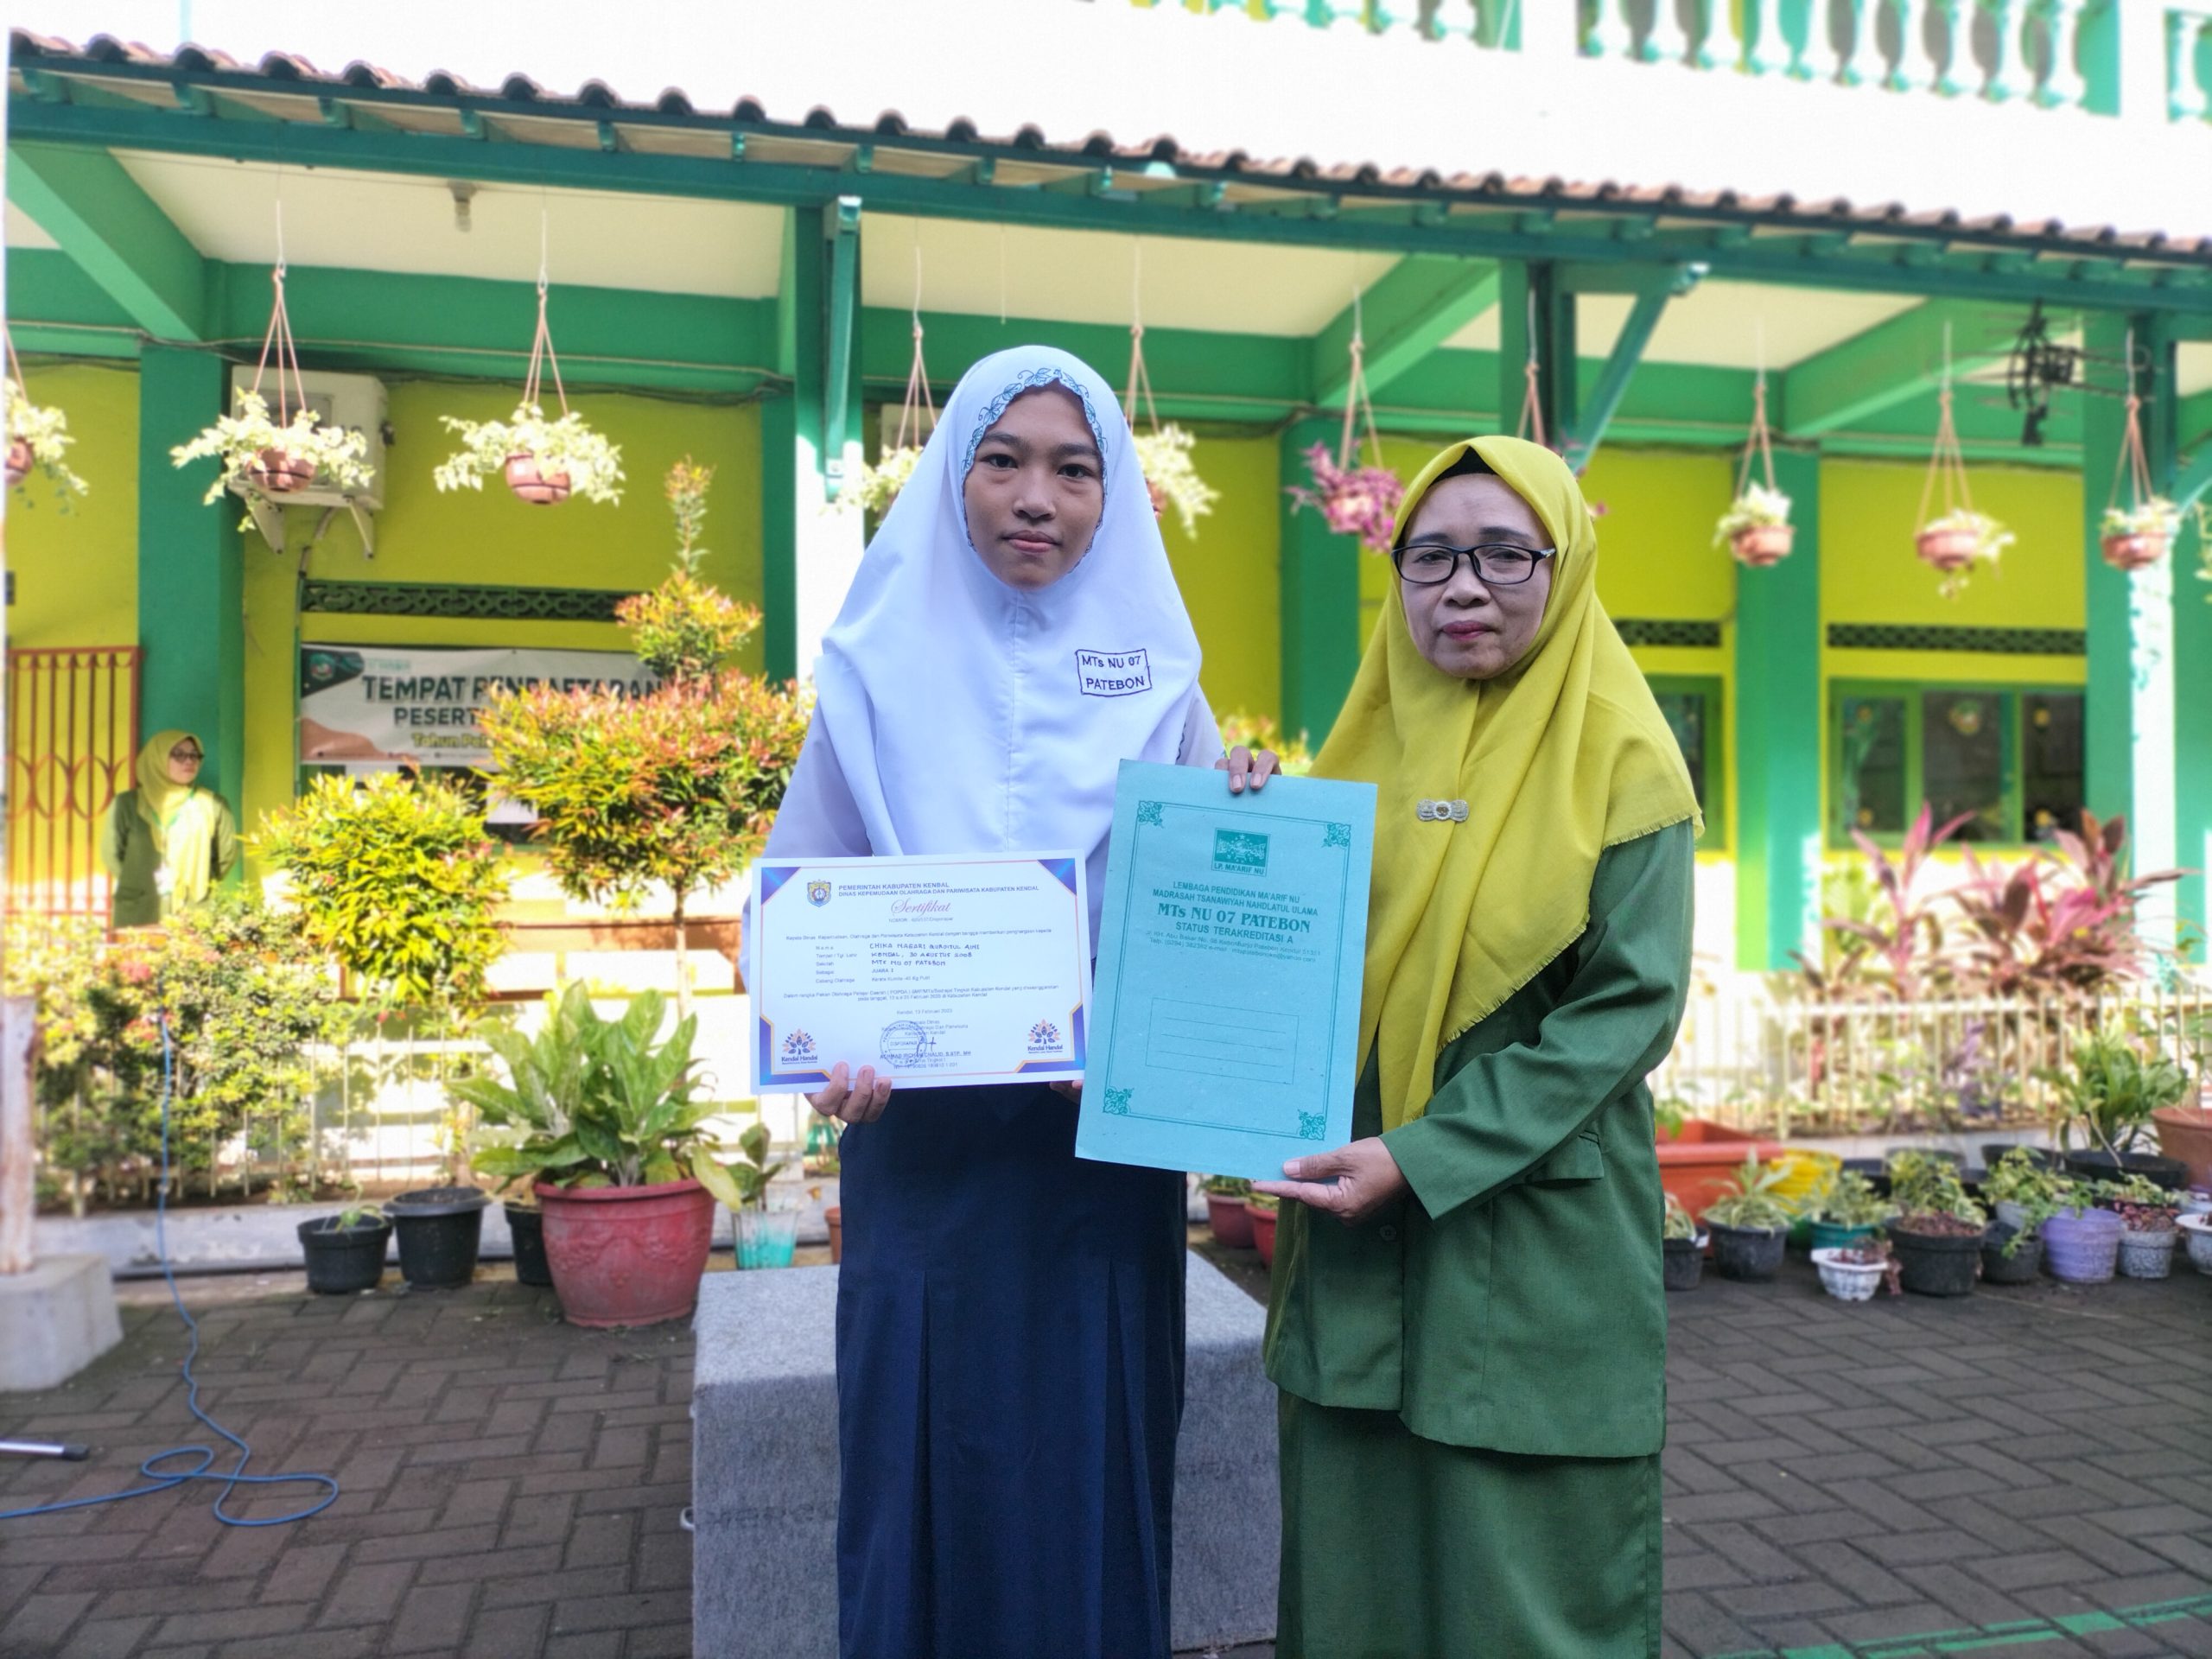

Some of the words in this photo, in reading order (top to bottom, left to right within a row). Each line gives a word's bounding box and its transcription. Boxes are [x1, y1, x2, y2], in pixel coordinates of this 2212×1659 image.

[1081, 655, 1104, 668] MTs
[1108, 658, 1124, 669] NU
[1128, 655, 1141, 666] 07
[362, 676, 467, 701] TEMPAT
[1086, 676, 1145, 690] PATEBON
[393, 707, 486, 726] PESERT
[411, 733, 459, 747] Tahun
[1225, 864, 1252, 873] MA'ARIF
[1153, 888, 1195, 901] MADRASAH
[1197, 893, 1244, 907] TSANAWIYAH
[1246, 899, 1290, 913] NAHDLATUL
[1292, 906, 1319, 916] ULAMA
[1173, 881, 1210, 892] LEMBAGA
[1211, 886, 1256, 898] PENDIDIKAN
[1258, 891, 1288, 902] MA'ARIF
[1289, 895, 1300, 904] NU
[891, 898, 951, 917] Sertifikat
[1158, 903, 1186, 918] MTs
[1191, 907, 1212, 921] NU
[1217, 910, 1236, 924] 07
[1241, 912, 1311, 933] PATEBON
[1175, 921, 1210, 933] STATUS
[1213, 925, 1284, 944] TERAKREDITASI
[1287, 936, 1294, 944] A
